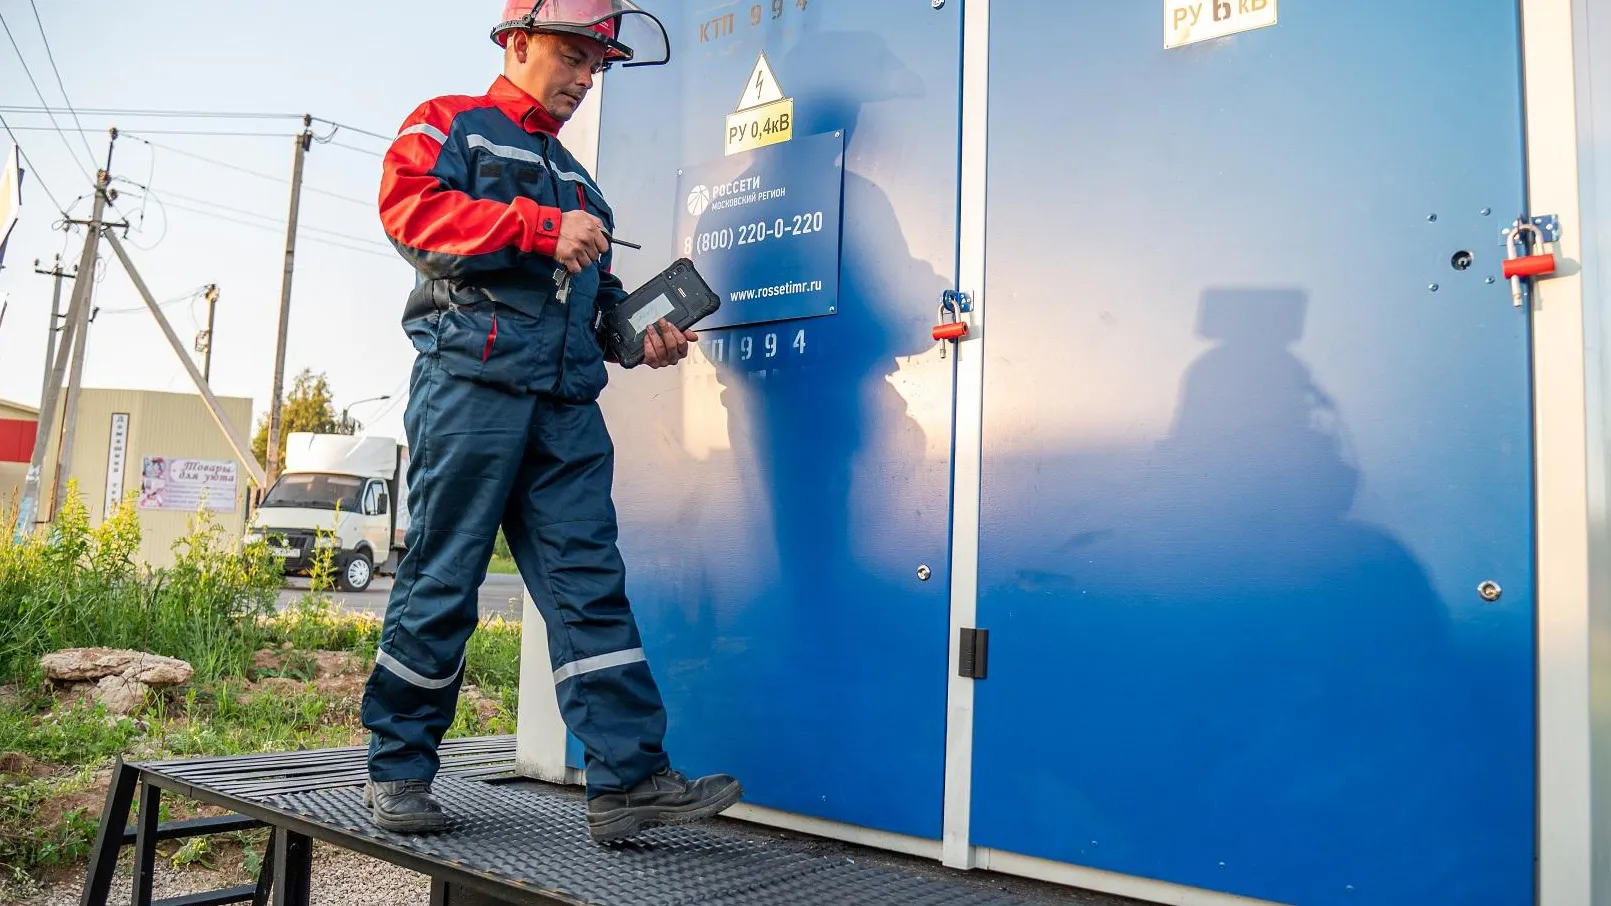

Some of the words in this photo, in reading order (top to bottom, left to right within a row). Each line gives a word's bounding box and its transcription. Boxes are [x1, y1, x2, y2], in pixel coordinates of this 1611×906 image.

[699, 13, 734, 45] КТП
[729, 123, 747, 144] РУ
[751, 113, 790, 141] 0,4кВ
[711, 193, 756, 212] МОСКОВСКИЙ
[758, 187, 786, 202] РЕГИОН
[712, 176, 761, 198] РОССЕТИ
[684, 236, 693, 255] 8
[696, 227, 734, 255] (800)
[737, 211, 823, 246] 220-0-220
[730, 280, 822, 302] www.rossetimr.ru
